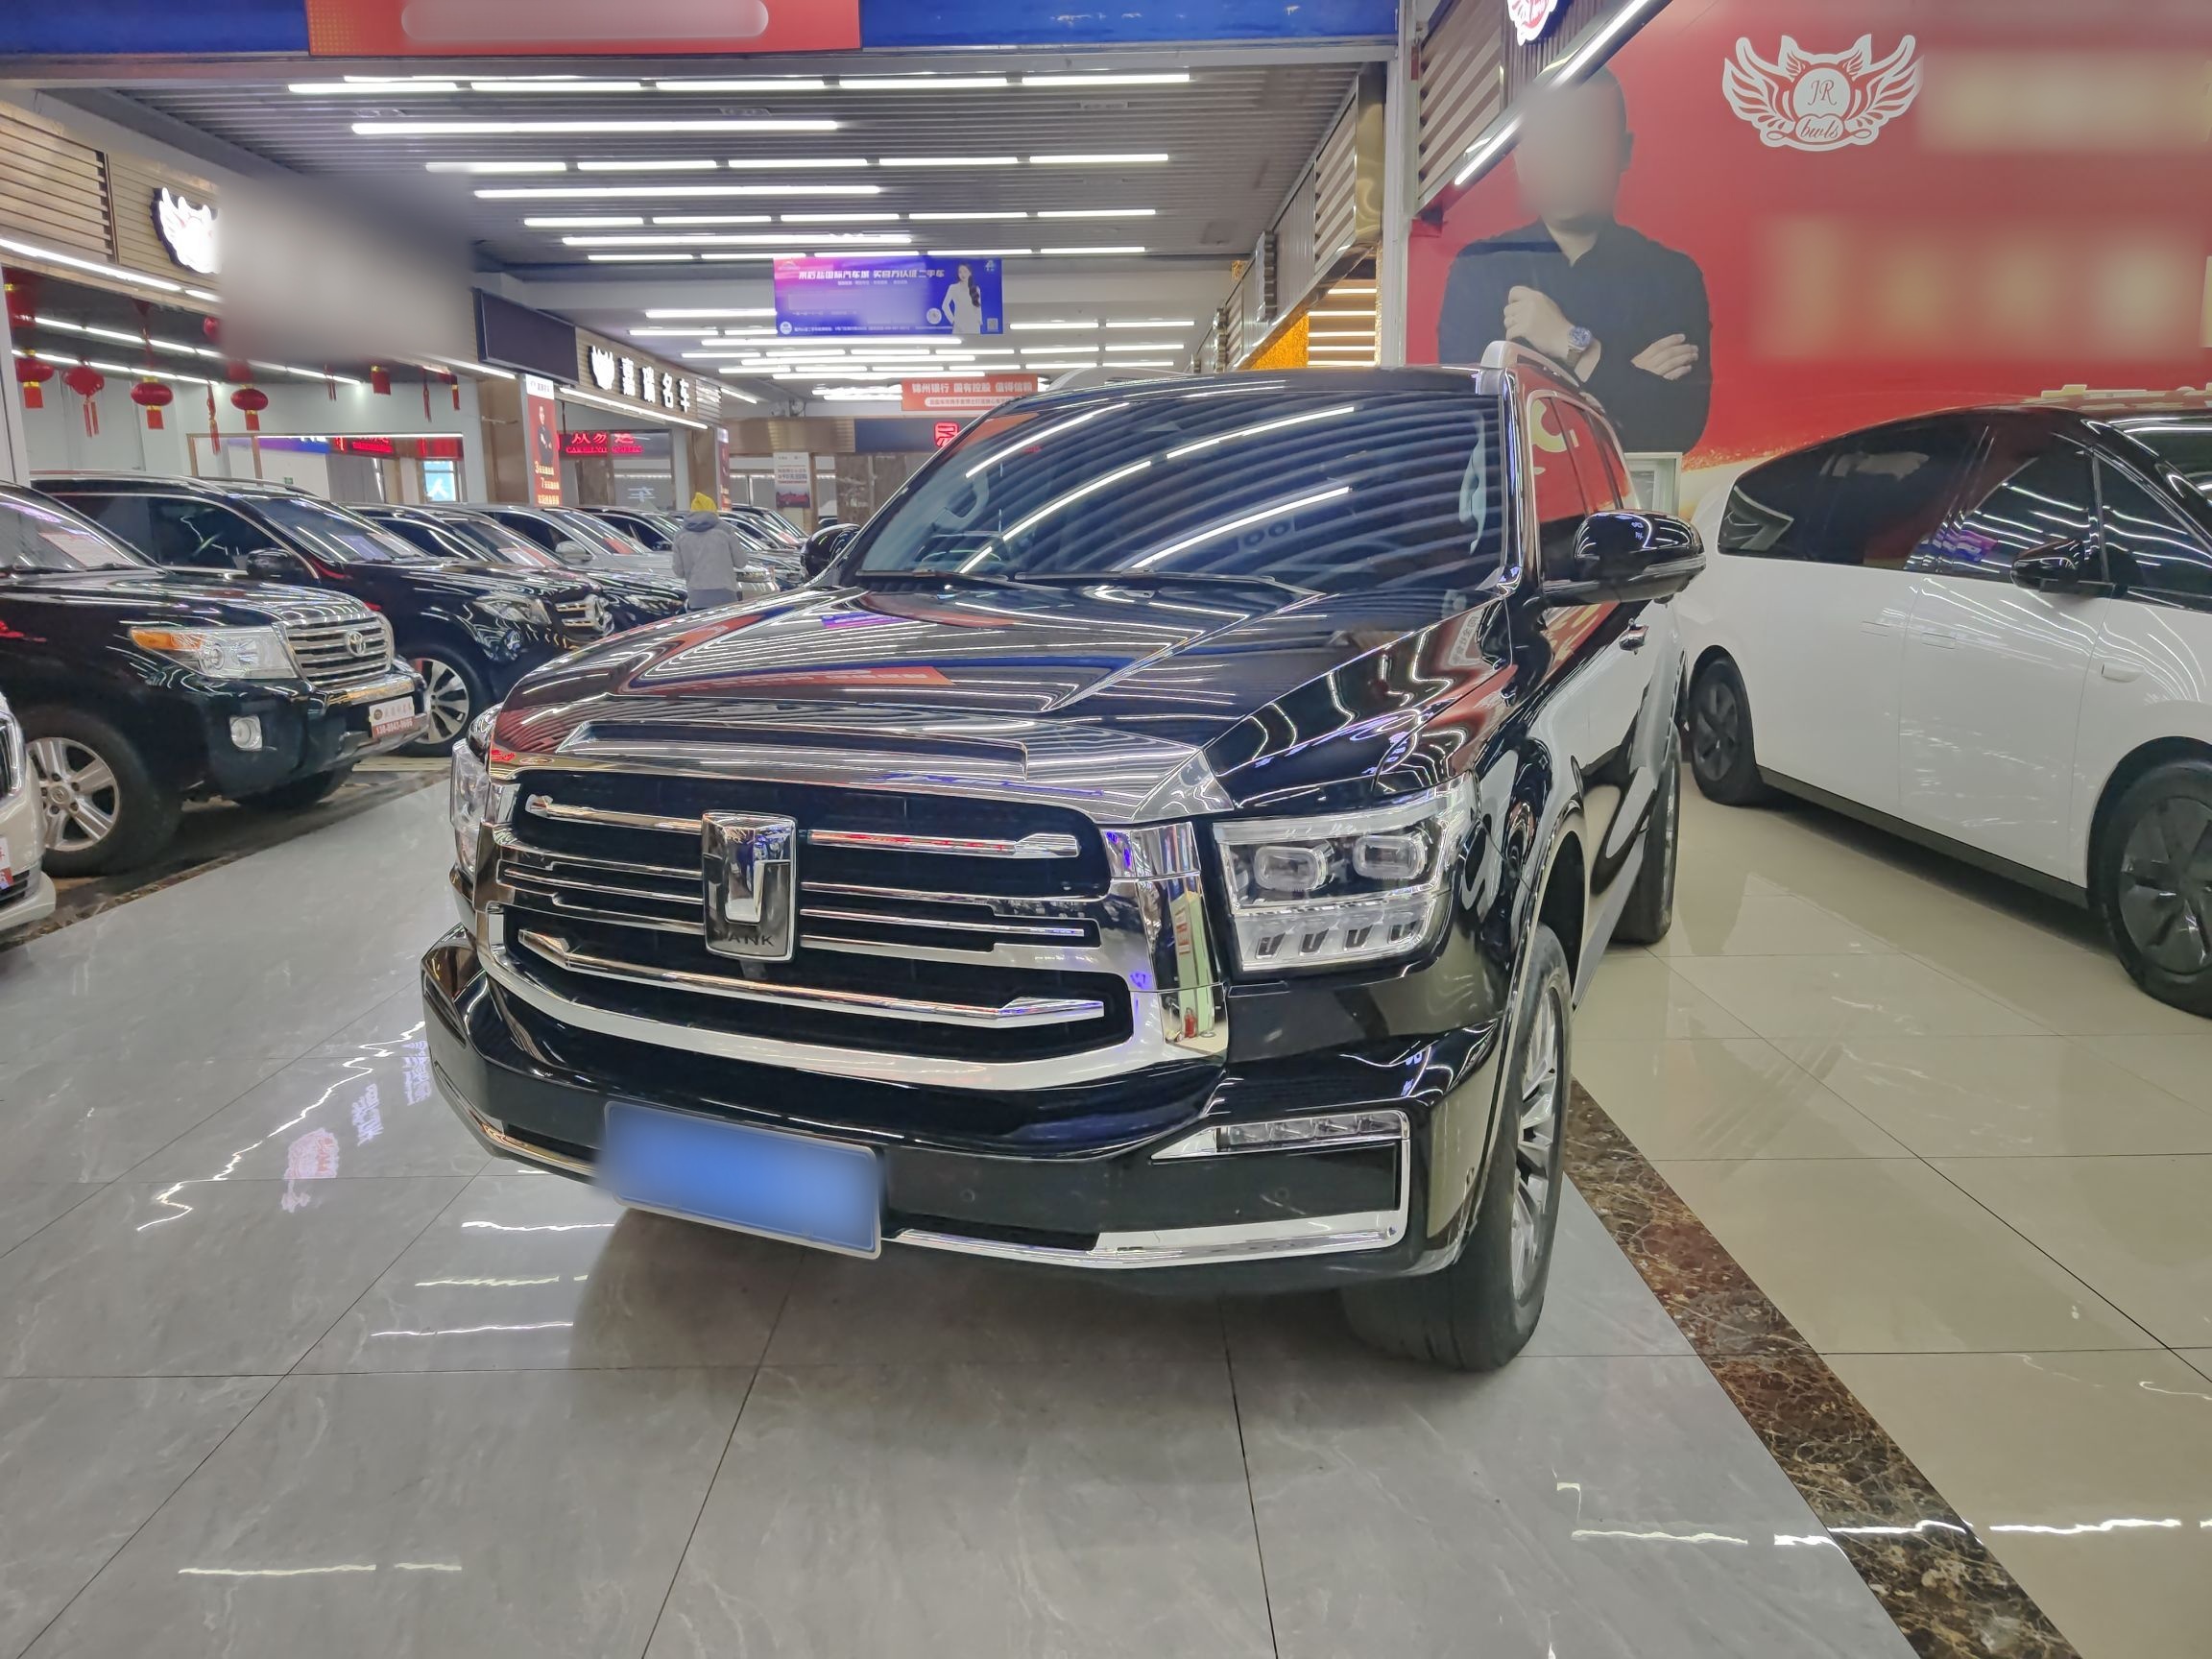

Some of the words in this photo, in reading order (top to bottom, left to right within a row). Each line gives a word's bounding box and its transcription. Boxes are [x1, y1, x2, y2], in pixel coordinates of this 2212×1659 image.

[1807, 79, 1838, 107] JR
[911, 382, 950, 394] 锦州银行
[953, 382, 991, 394] 国有控股
[713, 929, 775, 947] ANK
